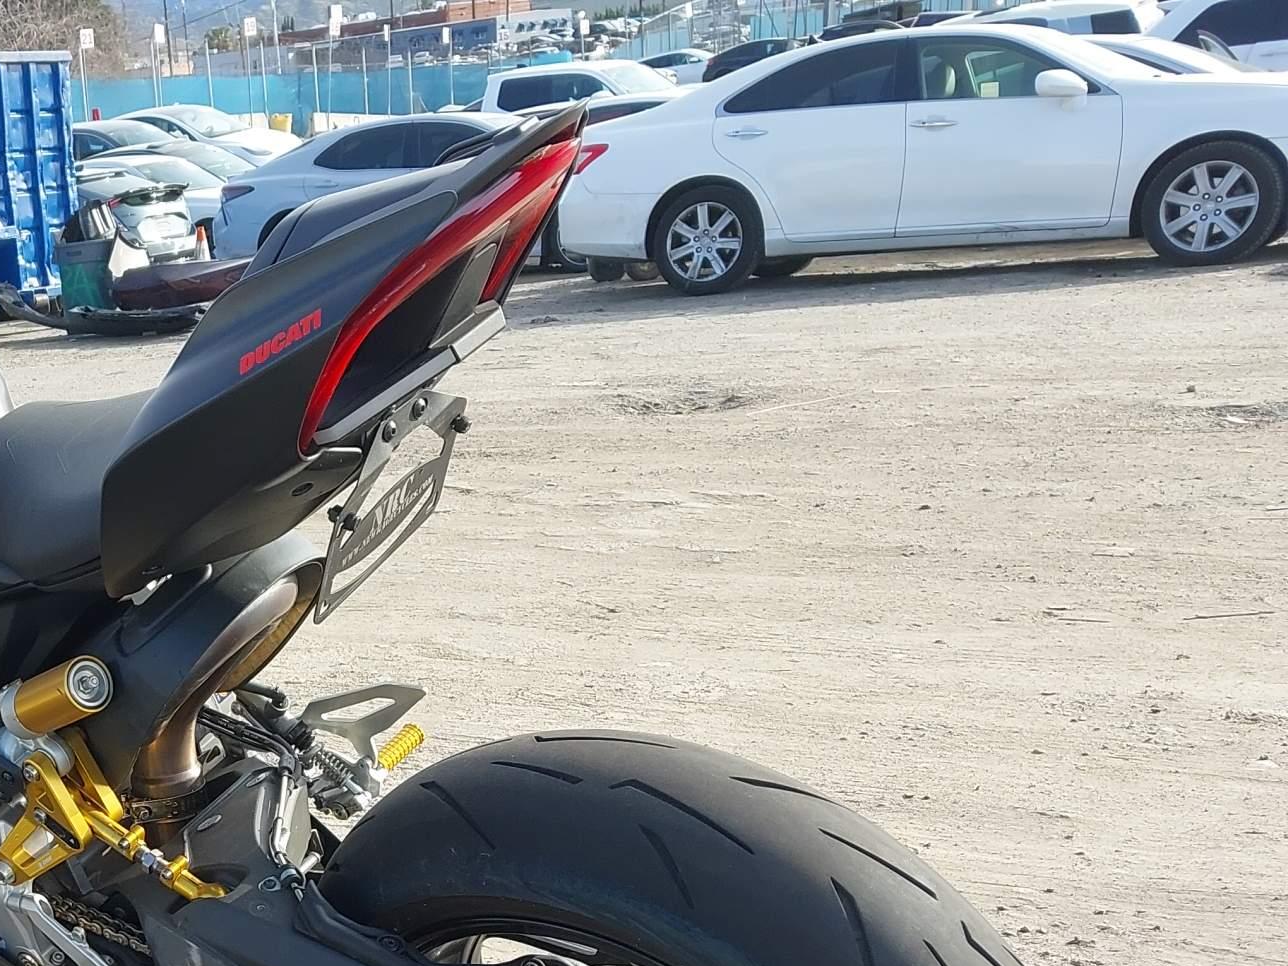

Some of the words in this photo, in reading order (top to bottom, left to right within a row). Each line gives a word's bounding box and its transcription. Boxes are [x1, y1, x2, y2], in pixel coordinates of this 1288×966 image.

[81, 33, 94, 45] 21
[498, 32, 510, 41] 15
[239, 308, 322, 375] DUCATI
